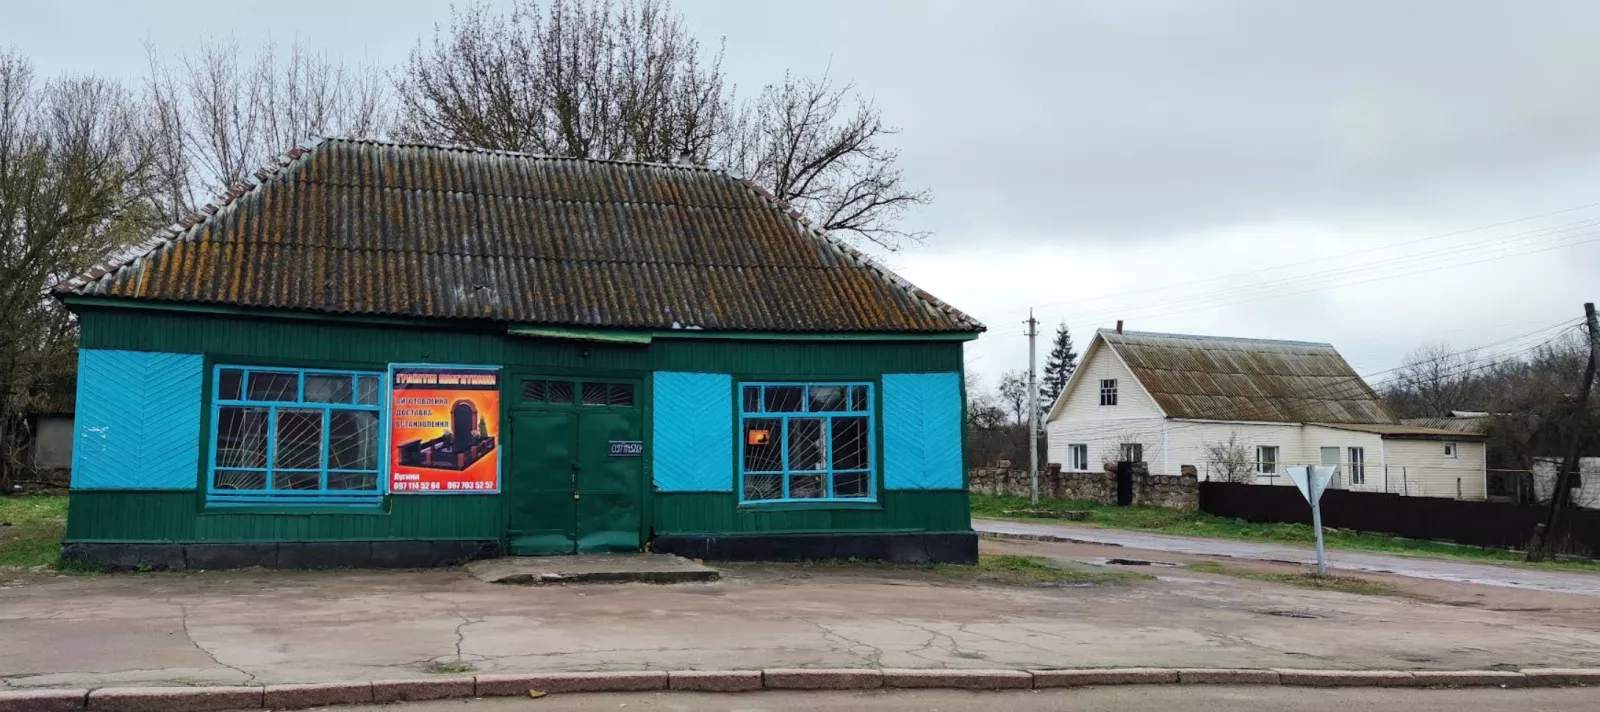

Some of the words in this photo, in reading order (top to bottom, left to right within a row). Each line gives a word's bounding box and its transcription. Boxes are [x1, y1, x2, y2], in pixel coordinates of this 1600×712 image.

[394, 473, 420, 481] Лугини
[393, 482, 407, 490] 097
[408, 482, 419, 490] 114
[420, 482, 430, 490] 52
[430, 482, 440, 490] 64
[447, 481, 460, 490] 067
[461, 481, 474, 490] 703
[475, 481, 484, 490] 52
[485, 481, 493, 490] 57
